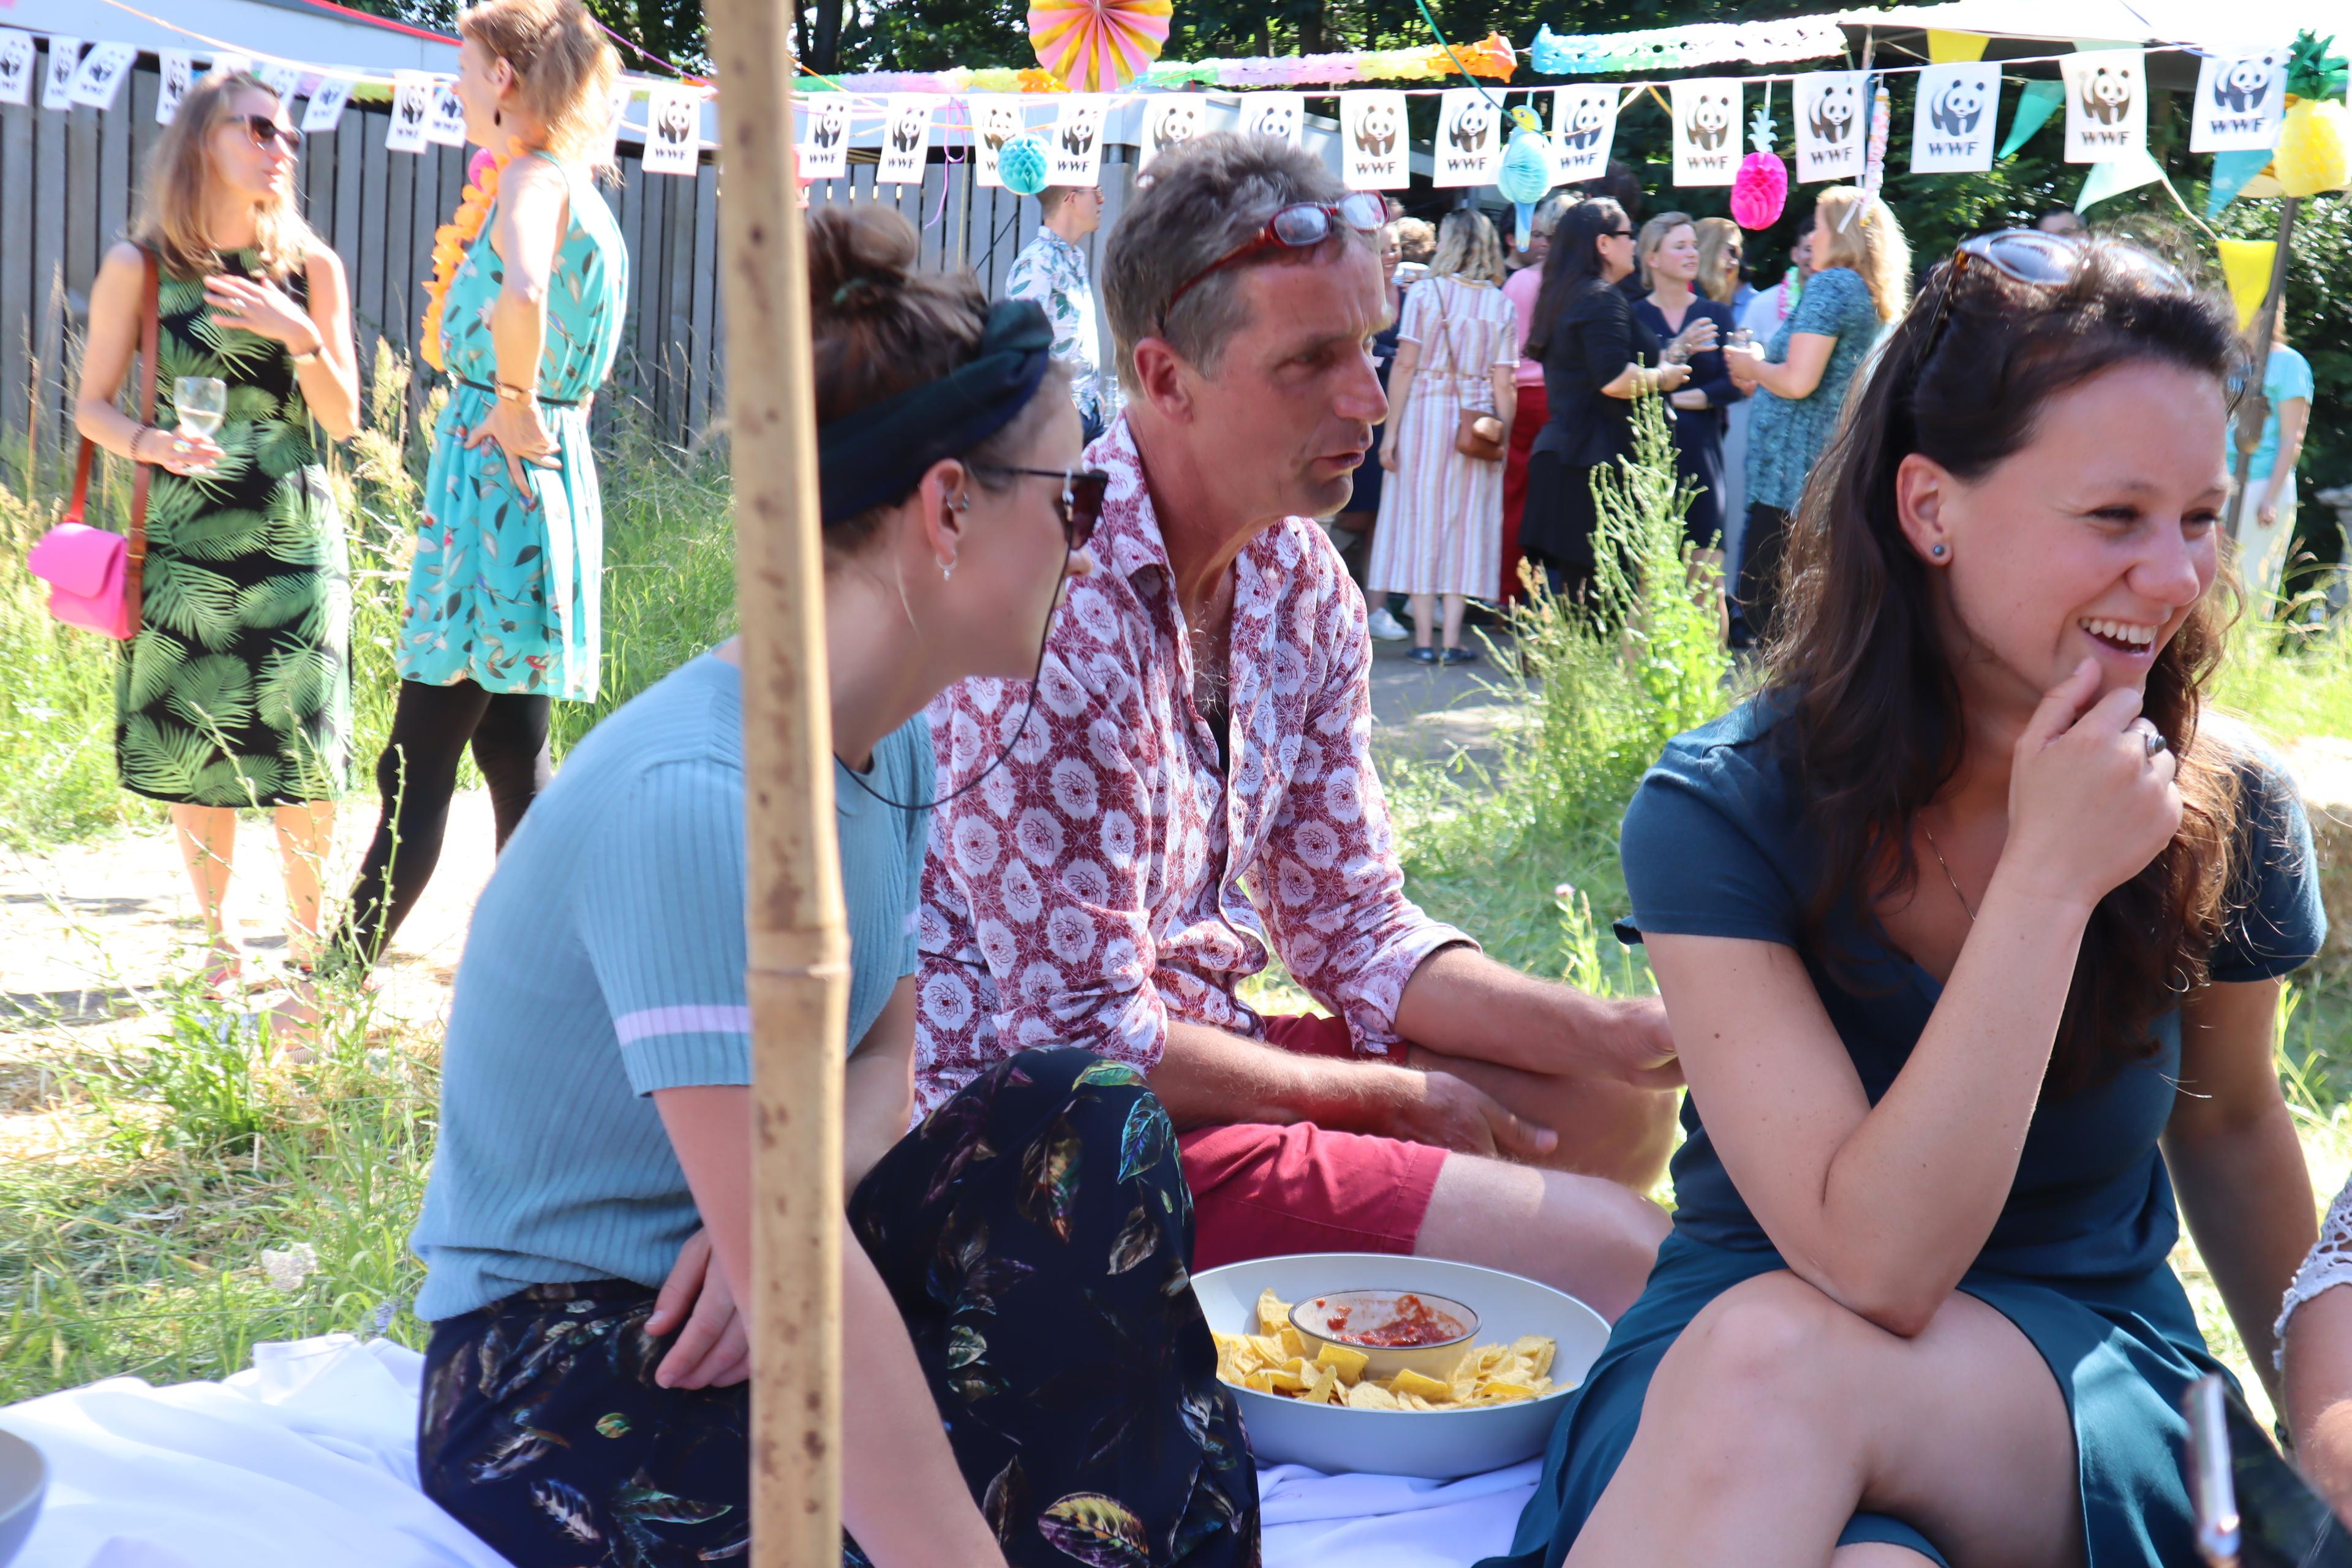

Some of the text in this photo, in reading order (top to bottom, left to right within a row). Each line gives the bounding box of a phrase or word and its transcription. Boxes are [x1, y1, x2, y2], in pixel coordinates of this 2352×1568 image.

[2211, 117, 2266, 134] WWF
[2081, 130, 2130, 146] WWF
[655, 147, 686, 160] WWF
[1811, 146, 1853, 165] WWF
[1928, 141, 1979, 156] WWF
[809, 153, 837, 164] WWF
[888, 157, 916, 169] WWF
[1447, 157, 1487, 171] WWF
[1559, 152, 1598, 169] WWF
[1686, 156, 1729, 170] WWF
[1057, 160, 1090, 172] WWF
[1355, 161, 1396, 175] WWF
